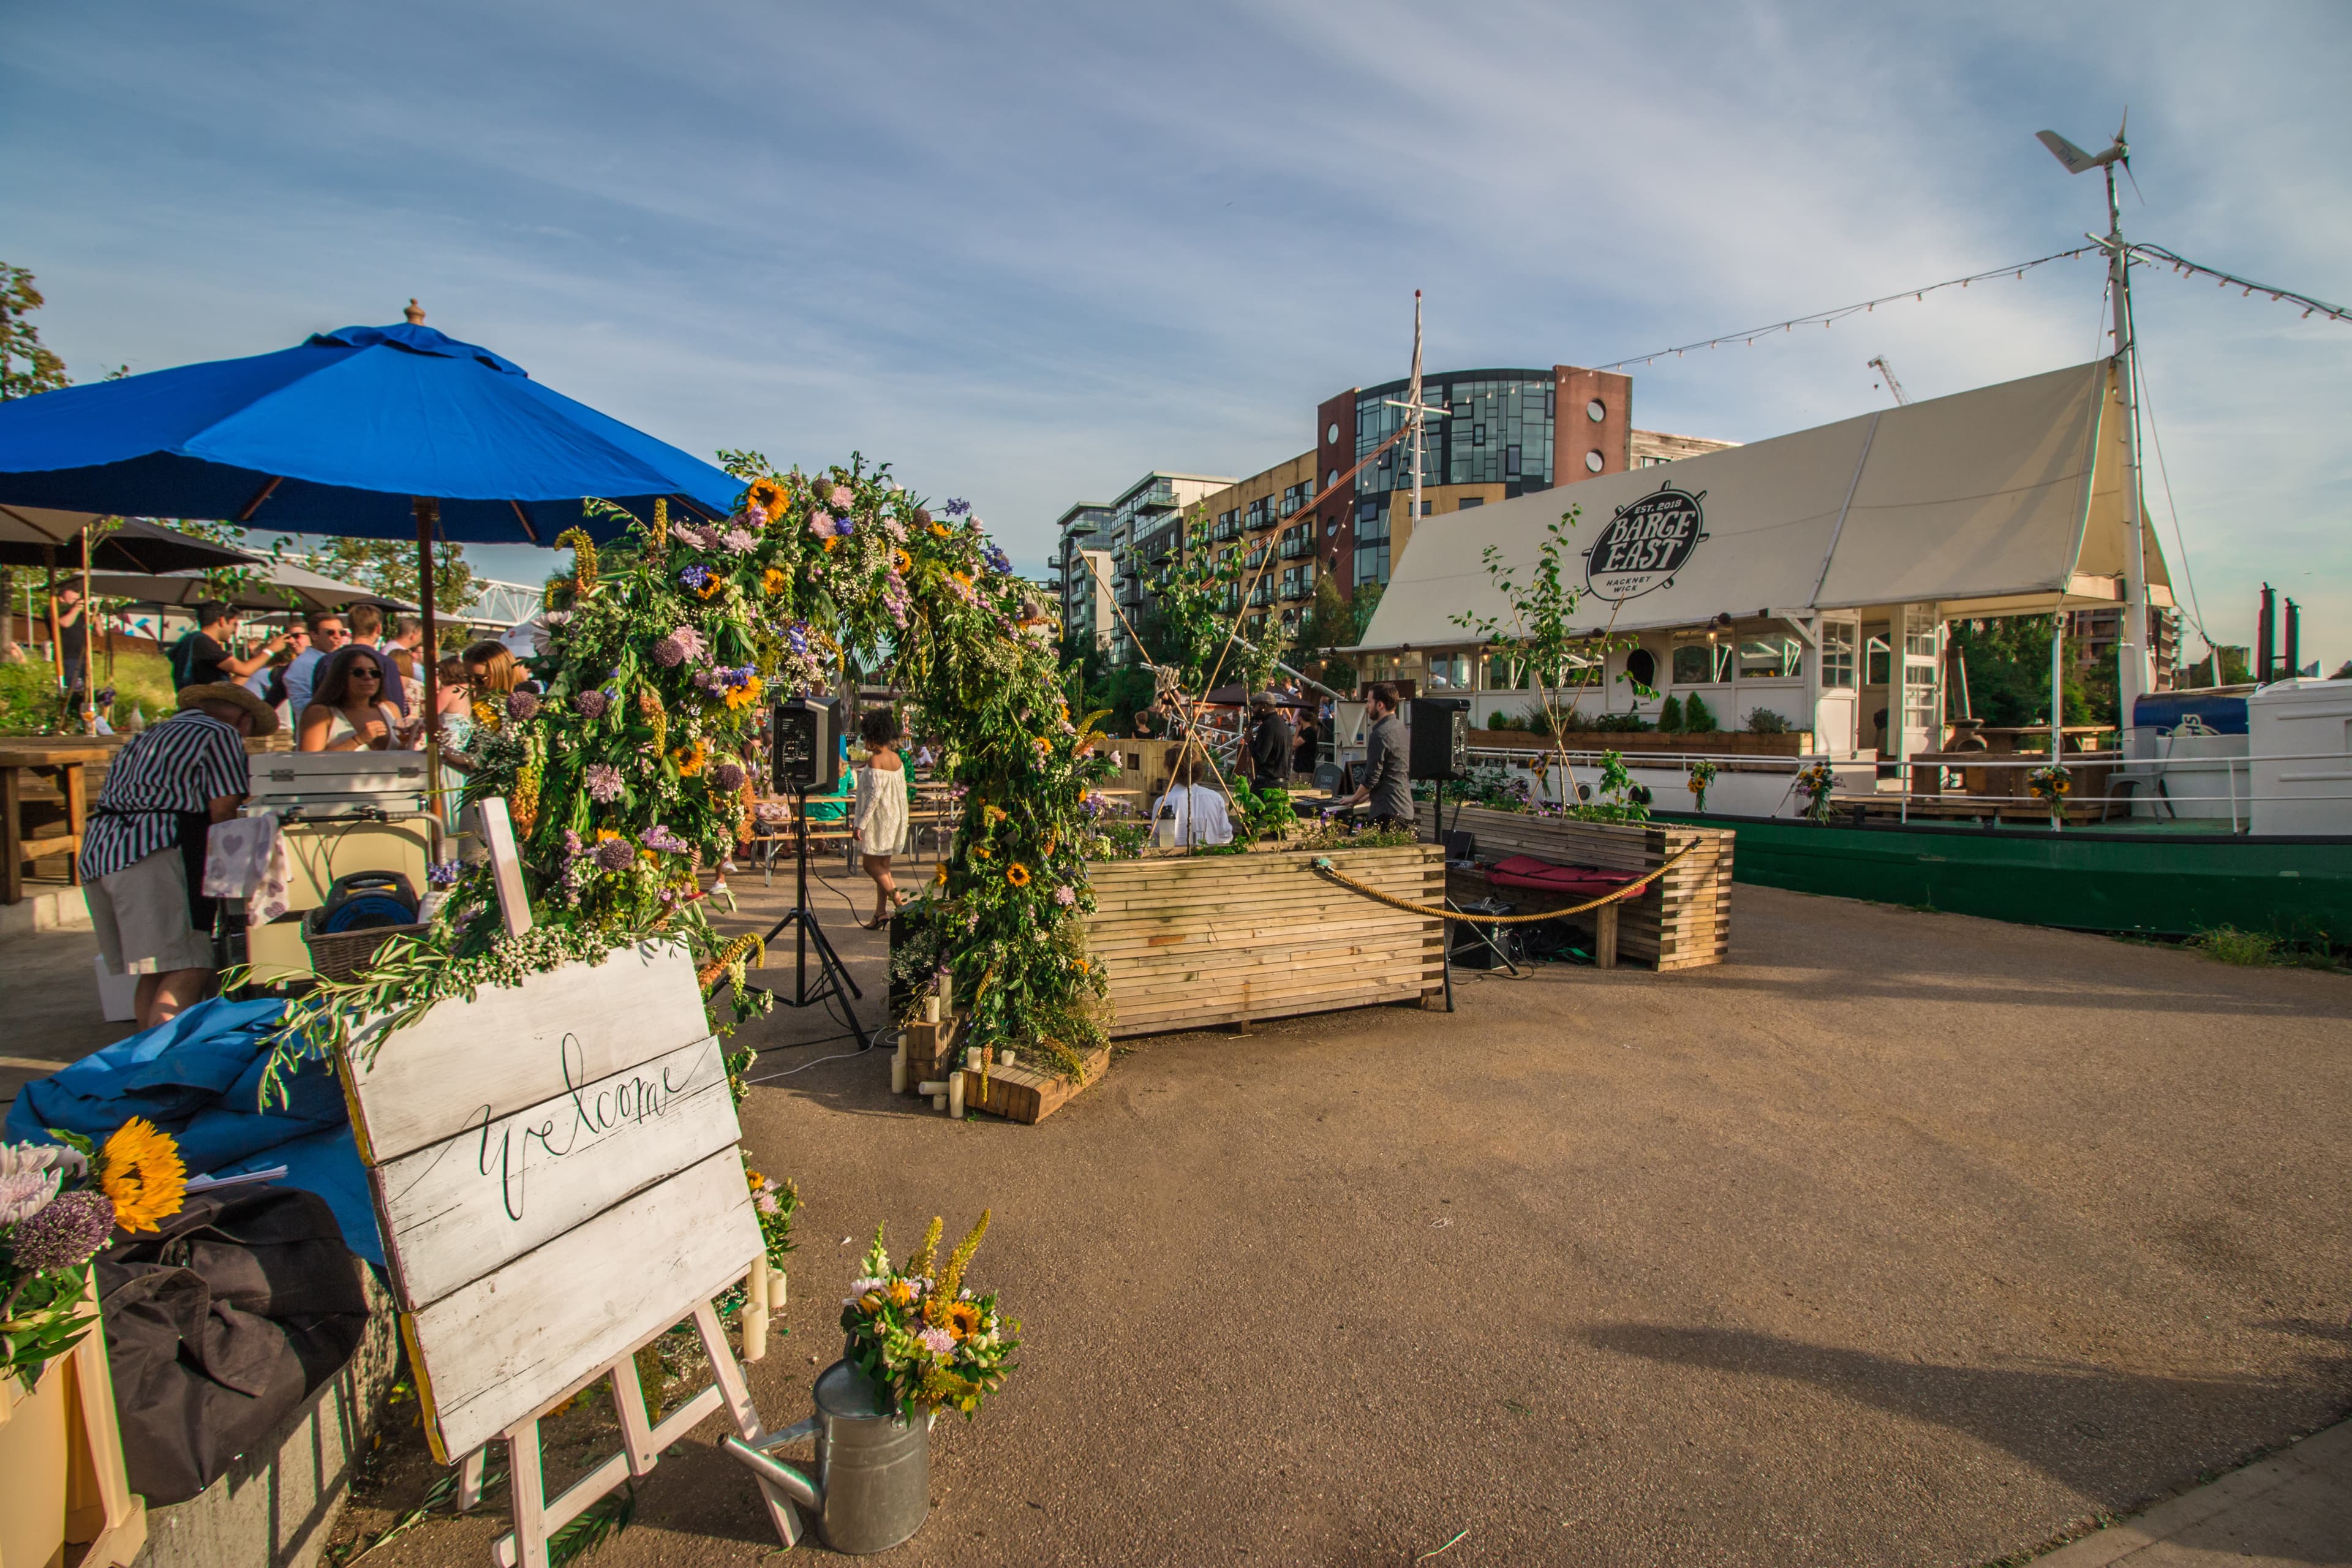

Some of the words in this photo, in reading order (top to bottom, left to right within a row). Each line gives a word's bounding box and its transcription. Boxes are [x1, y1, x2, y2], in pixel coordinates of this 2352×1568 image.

[1634, 504, 1654, 514] EST.
[1656, 499, 1683, 510] 2018
[1607, 510, 1696, 545] BARGE
[1601, 538, 1683, 571] EAST
[1606, 575, 1652, 586] HACKNEY
[387, 1032, 714, 1221] Welcome
